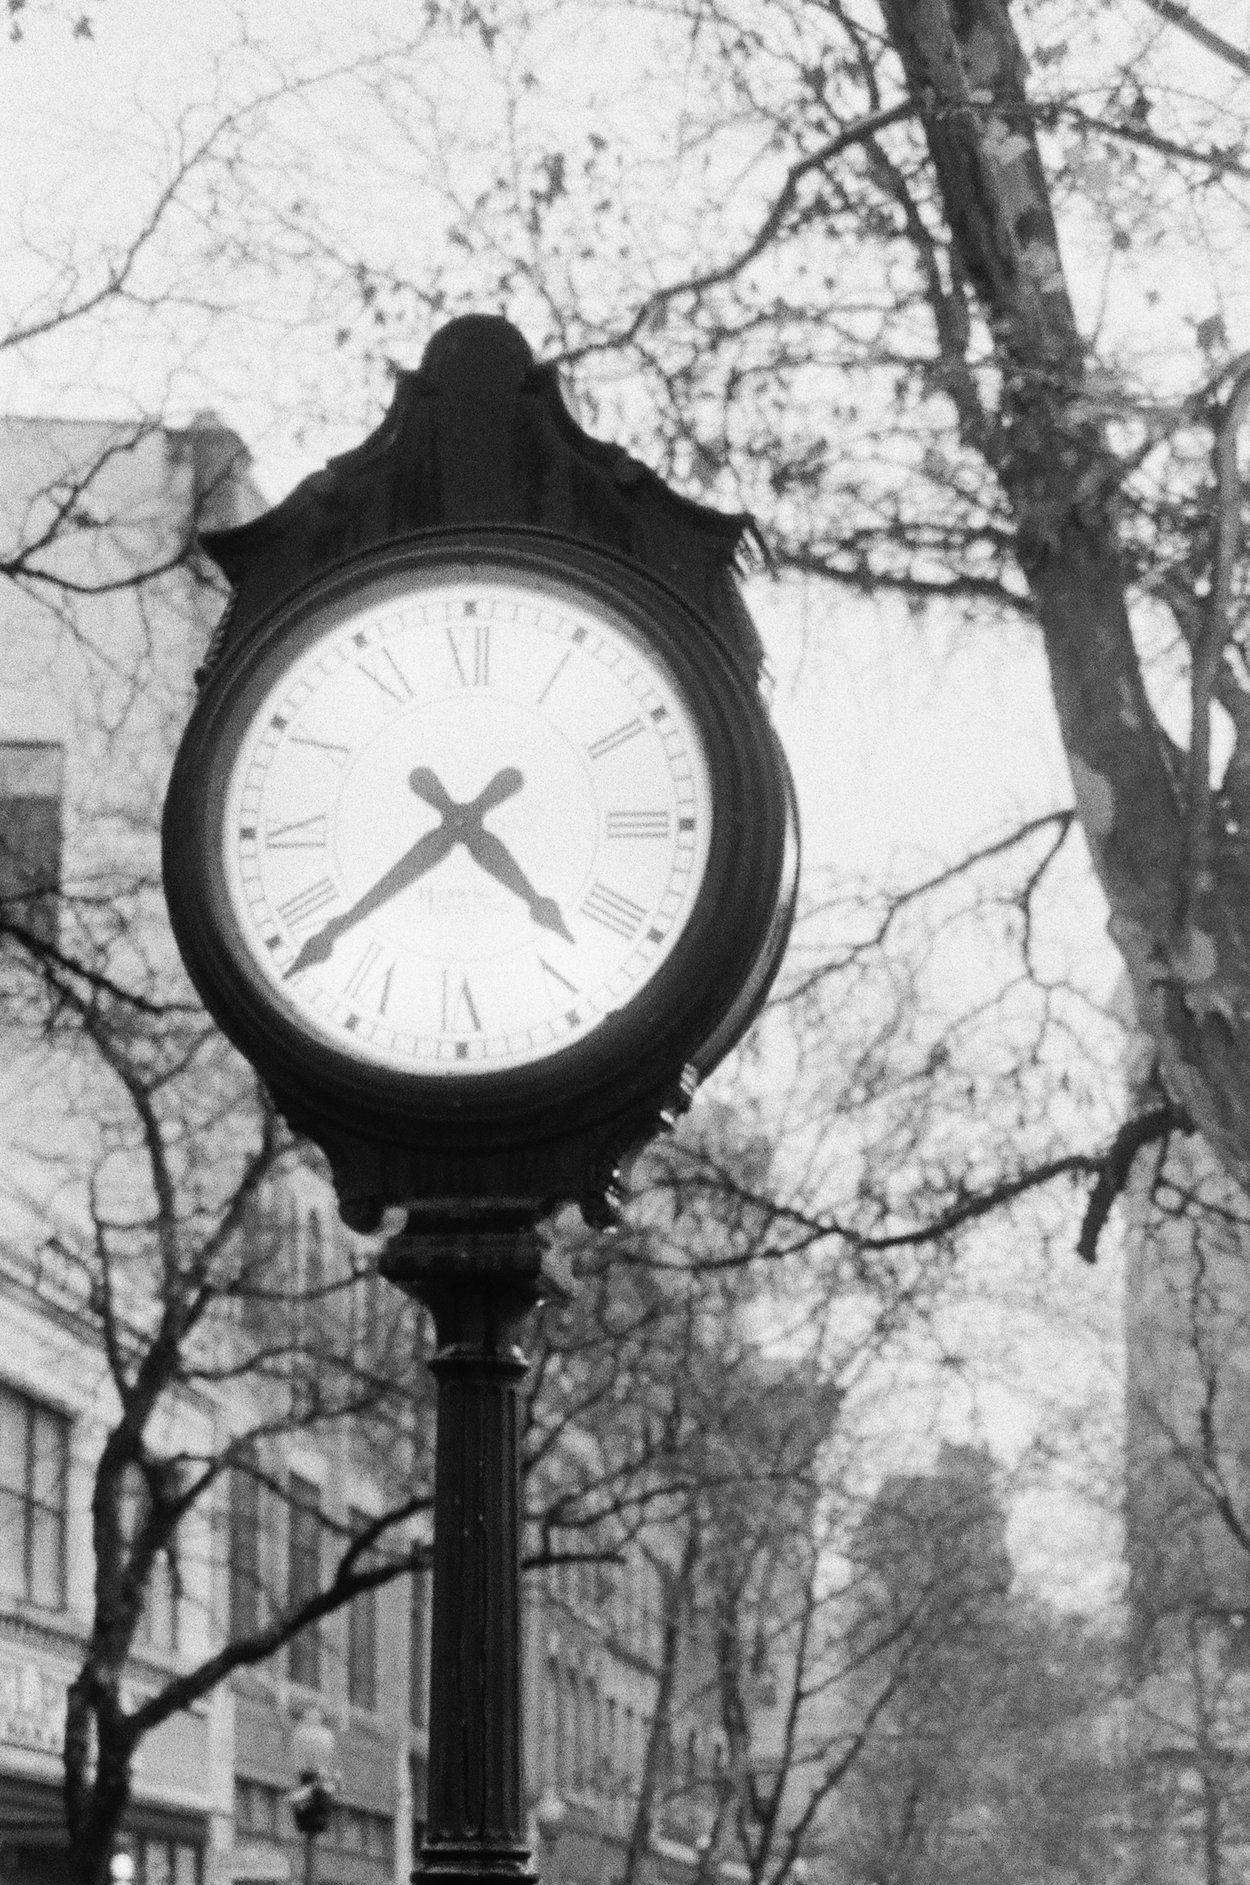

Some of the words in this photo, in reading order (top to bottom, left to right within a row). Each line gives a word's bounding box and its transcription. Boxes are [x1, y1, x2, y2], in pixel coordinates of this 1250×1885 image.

[445, 626, 490, 688] XII
[538, 649, 571, 704] I
[587, 716, 646, 760] II
[606, 811, 669, 838] III
[579, 881, 648, 940] IIII
